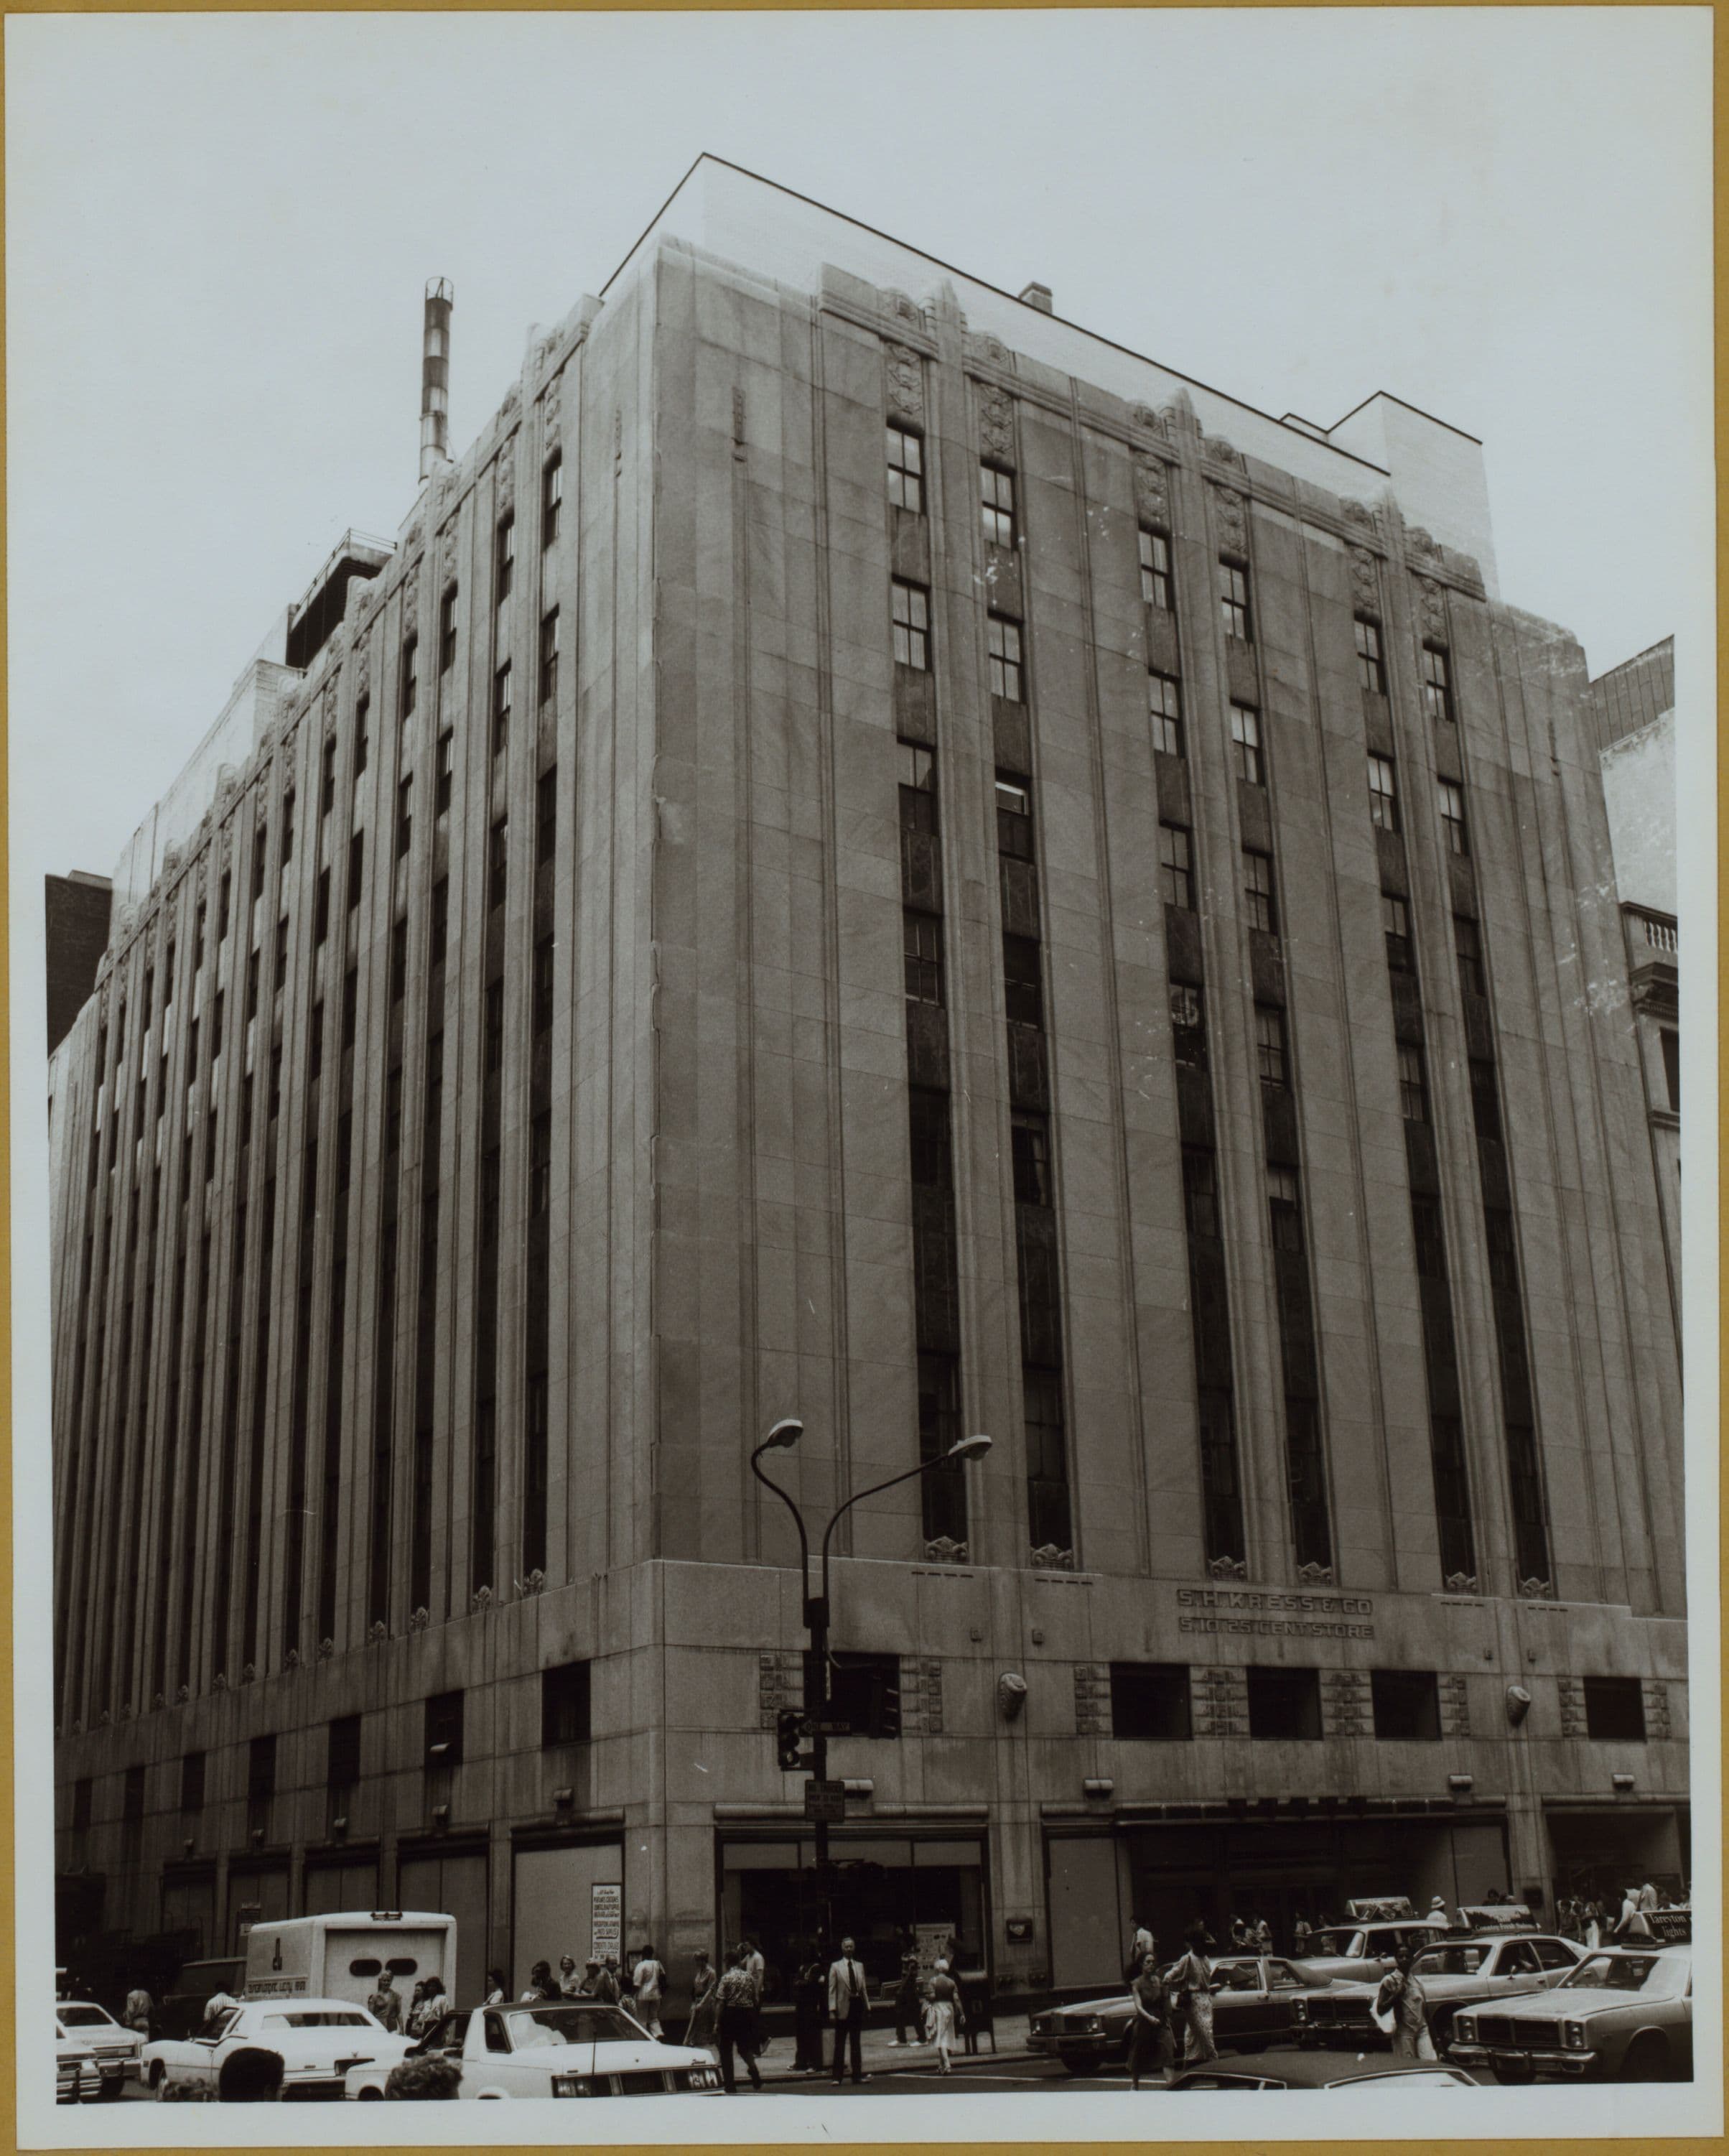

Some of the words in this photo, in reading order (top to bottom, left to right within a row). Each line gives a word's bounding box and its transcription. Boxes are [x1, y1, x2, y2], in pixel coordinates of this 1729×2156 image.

[1229, 1592, 1314, 1612] KRESS
[1323, 1598, 1333, 1612] &
[1259, 1620, 1307, 1637] CENT
[1313, 1623, 1374, 1639] STORE
[1649, 1913, 1687, 1925] Tareyton
[1662, 1924, 1687, 1939] lights
